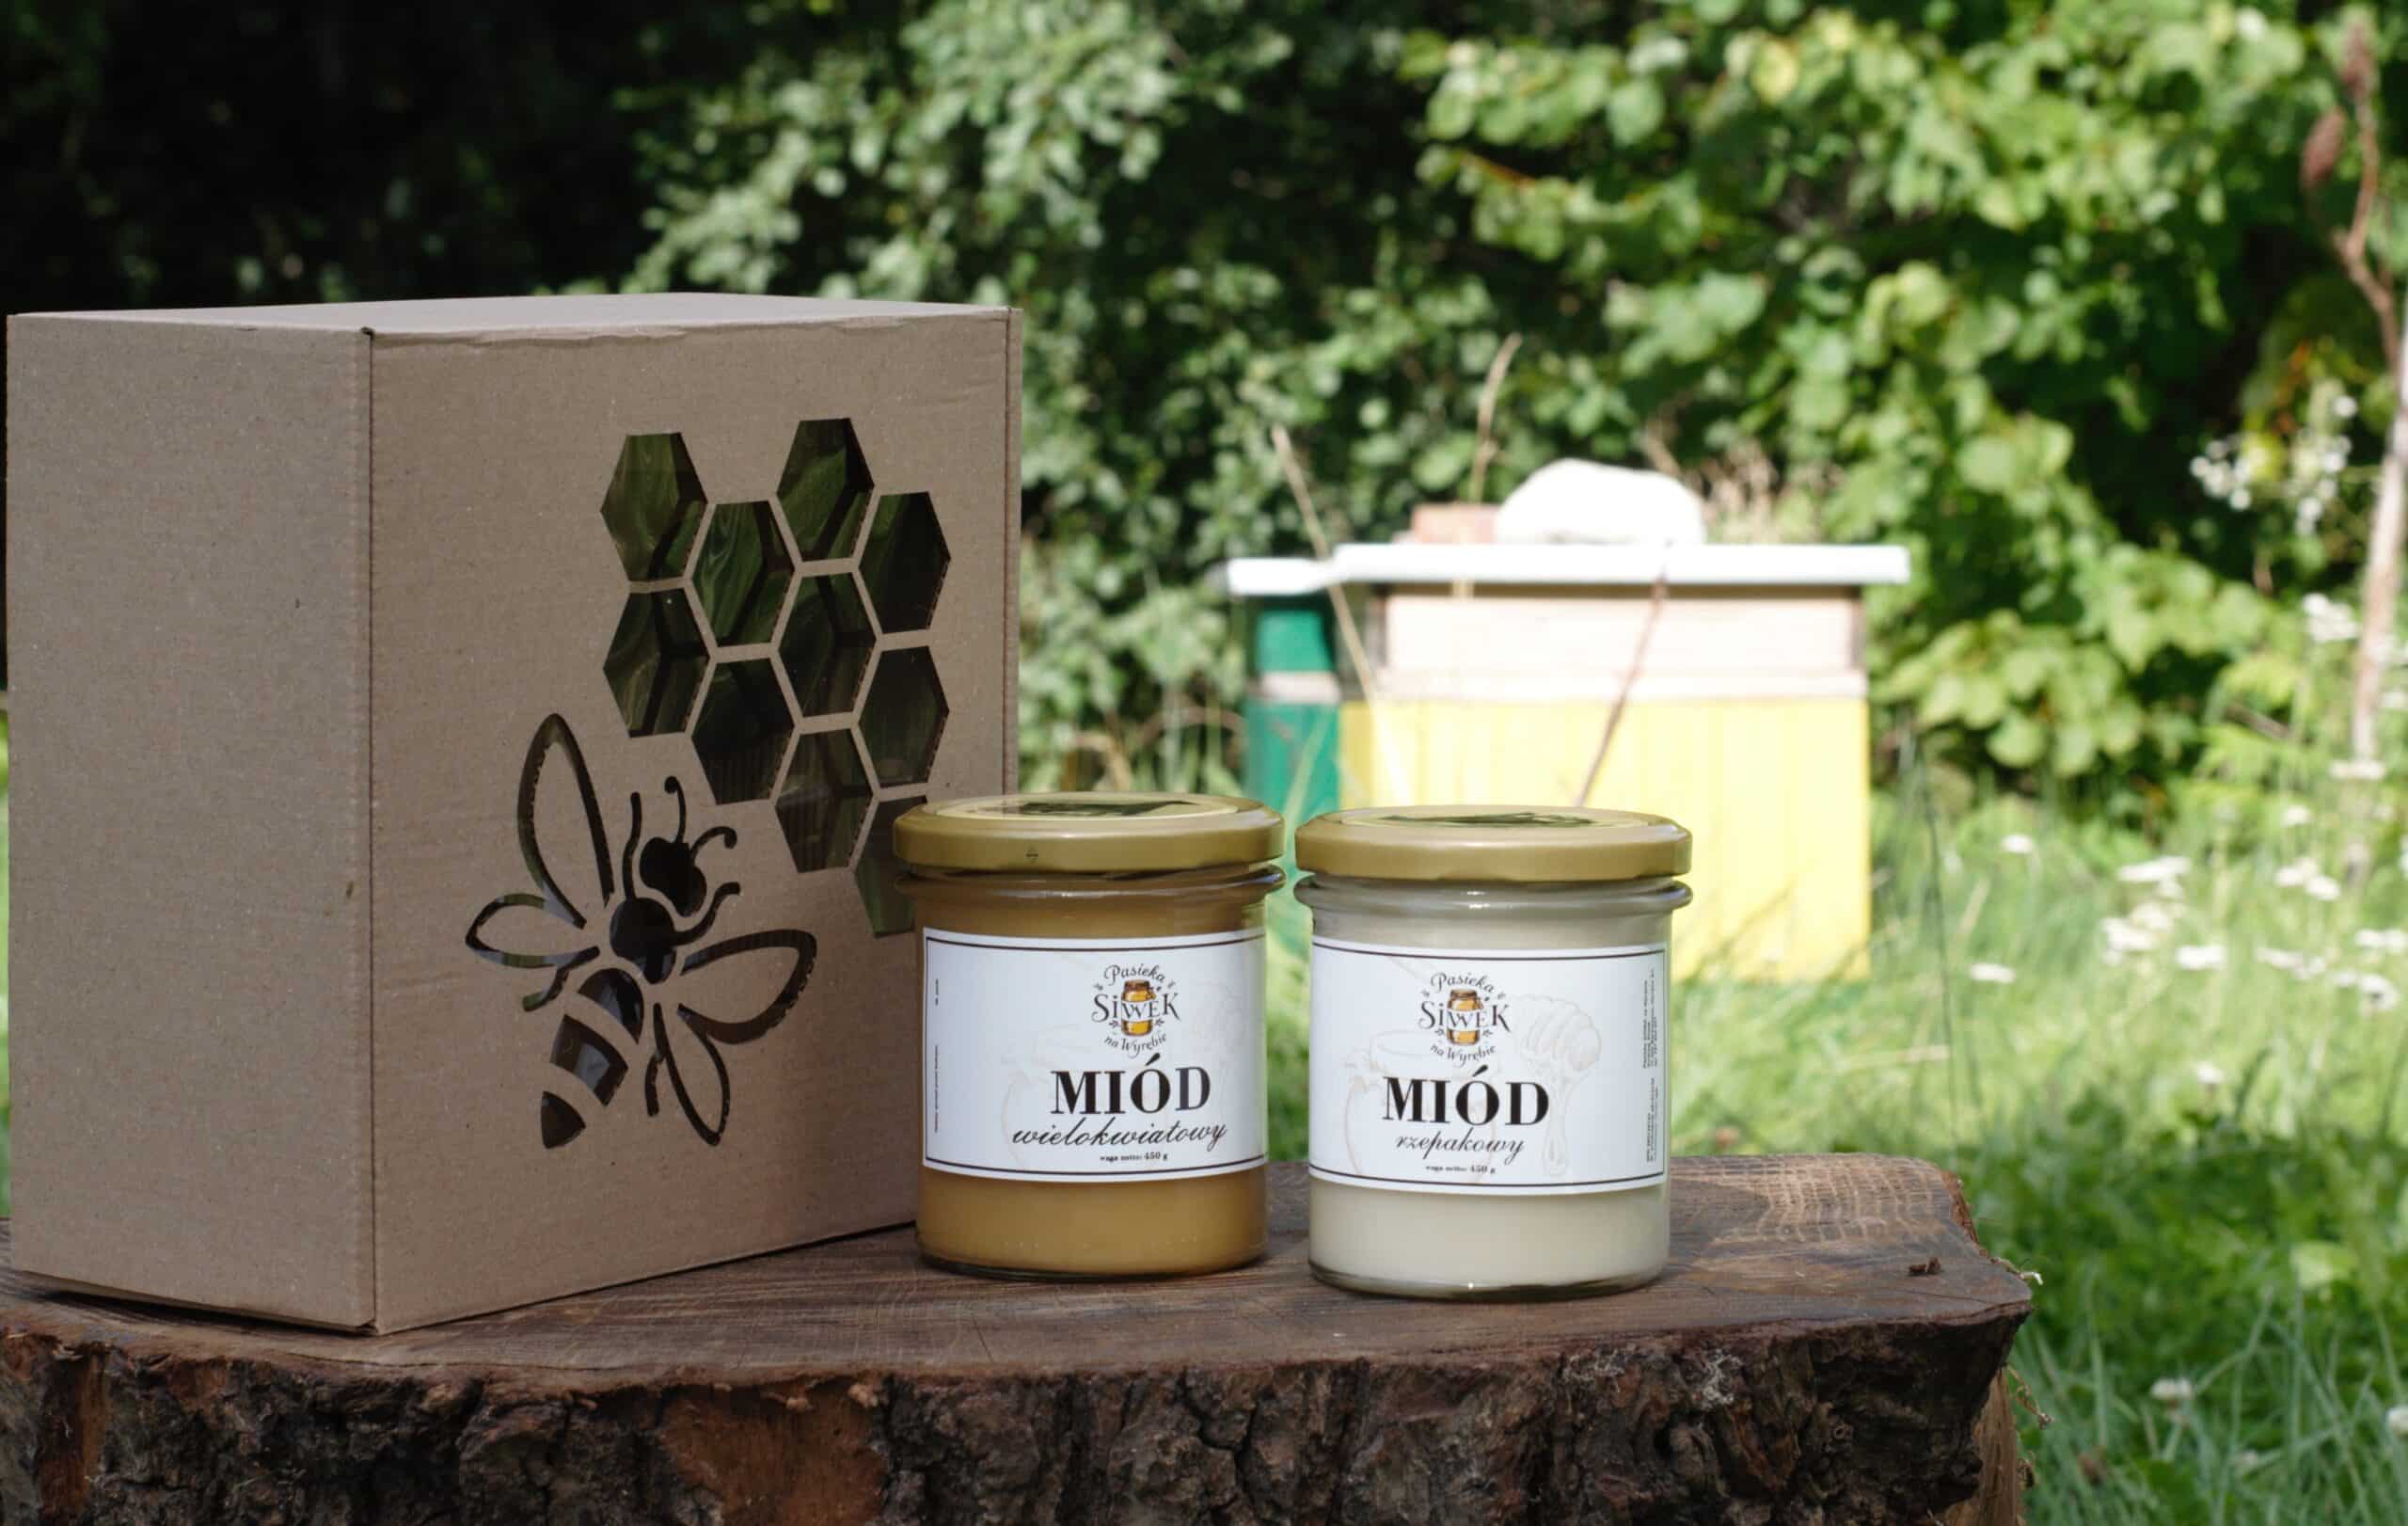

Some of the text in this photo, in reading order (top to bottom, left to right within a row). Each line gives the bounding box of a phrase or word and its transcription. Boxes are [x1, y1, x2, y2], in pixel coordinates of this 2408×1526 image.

[1104, 963, 1165, 986] Pasieka
[1430, 971, 1495, 993] Pasieka
[1104, 1036, 1118, 1048] na
[1430, 1042, 1444, 1057] na
[1051, 1053, 1211, 1115] MIÓD
[1383, 1065, 1549, 1126] MIÓD
[1012, 1117, 1228, 1152] wielokwiatowy
[1144, 1152, 1161, 1160] 450
[1396, 1127, 1524, 1166] rzepakowy
[1470, 1165, 1488, 1173] 450
